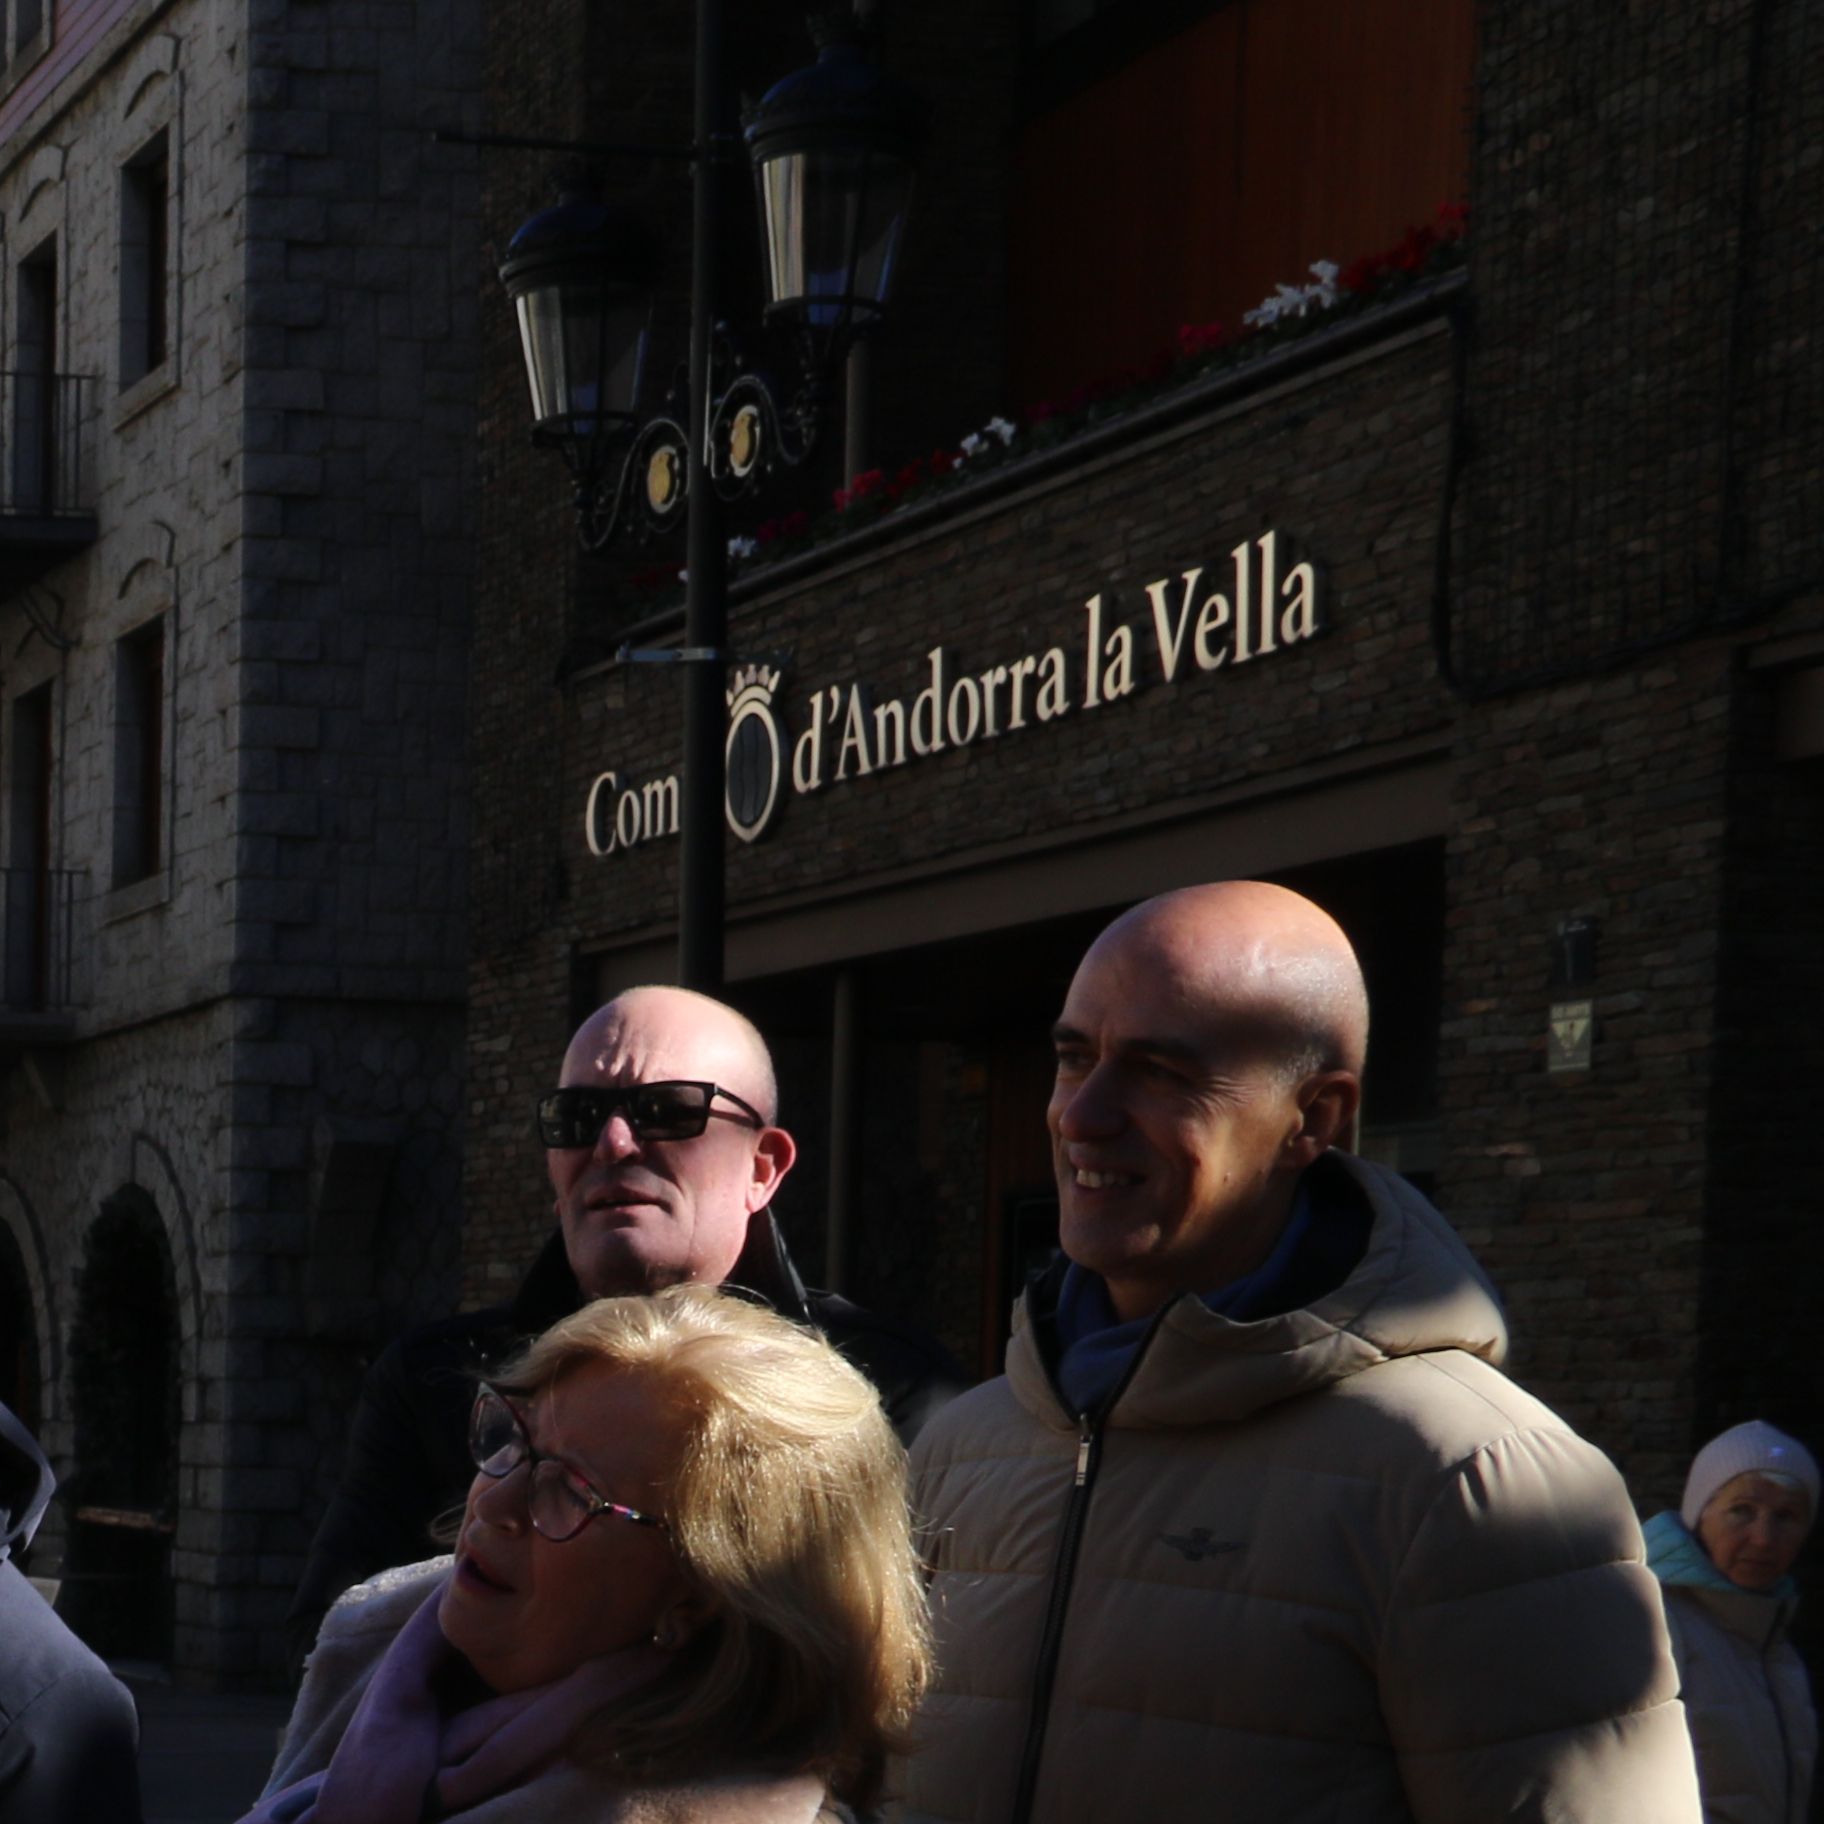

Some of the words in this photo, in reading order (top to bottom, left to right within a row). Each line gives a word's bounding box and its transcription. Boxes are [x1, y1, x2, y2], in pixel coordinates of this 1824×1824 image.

[585, 771, 680, 856] Com
[792, 646, 1071, 794] d'Andorra
[1082, 593, 1136, 710] la
[1144, 529, 1320, 683] Vella
